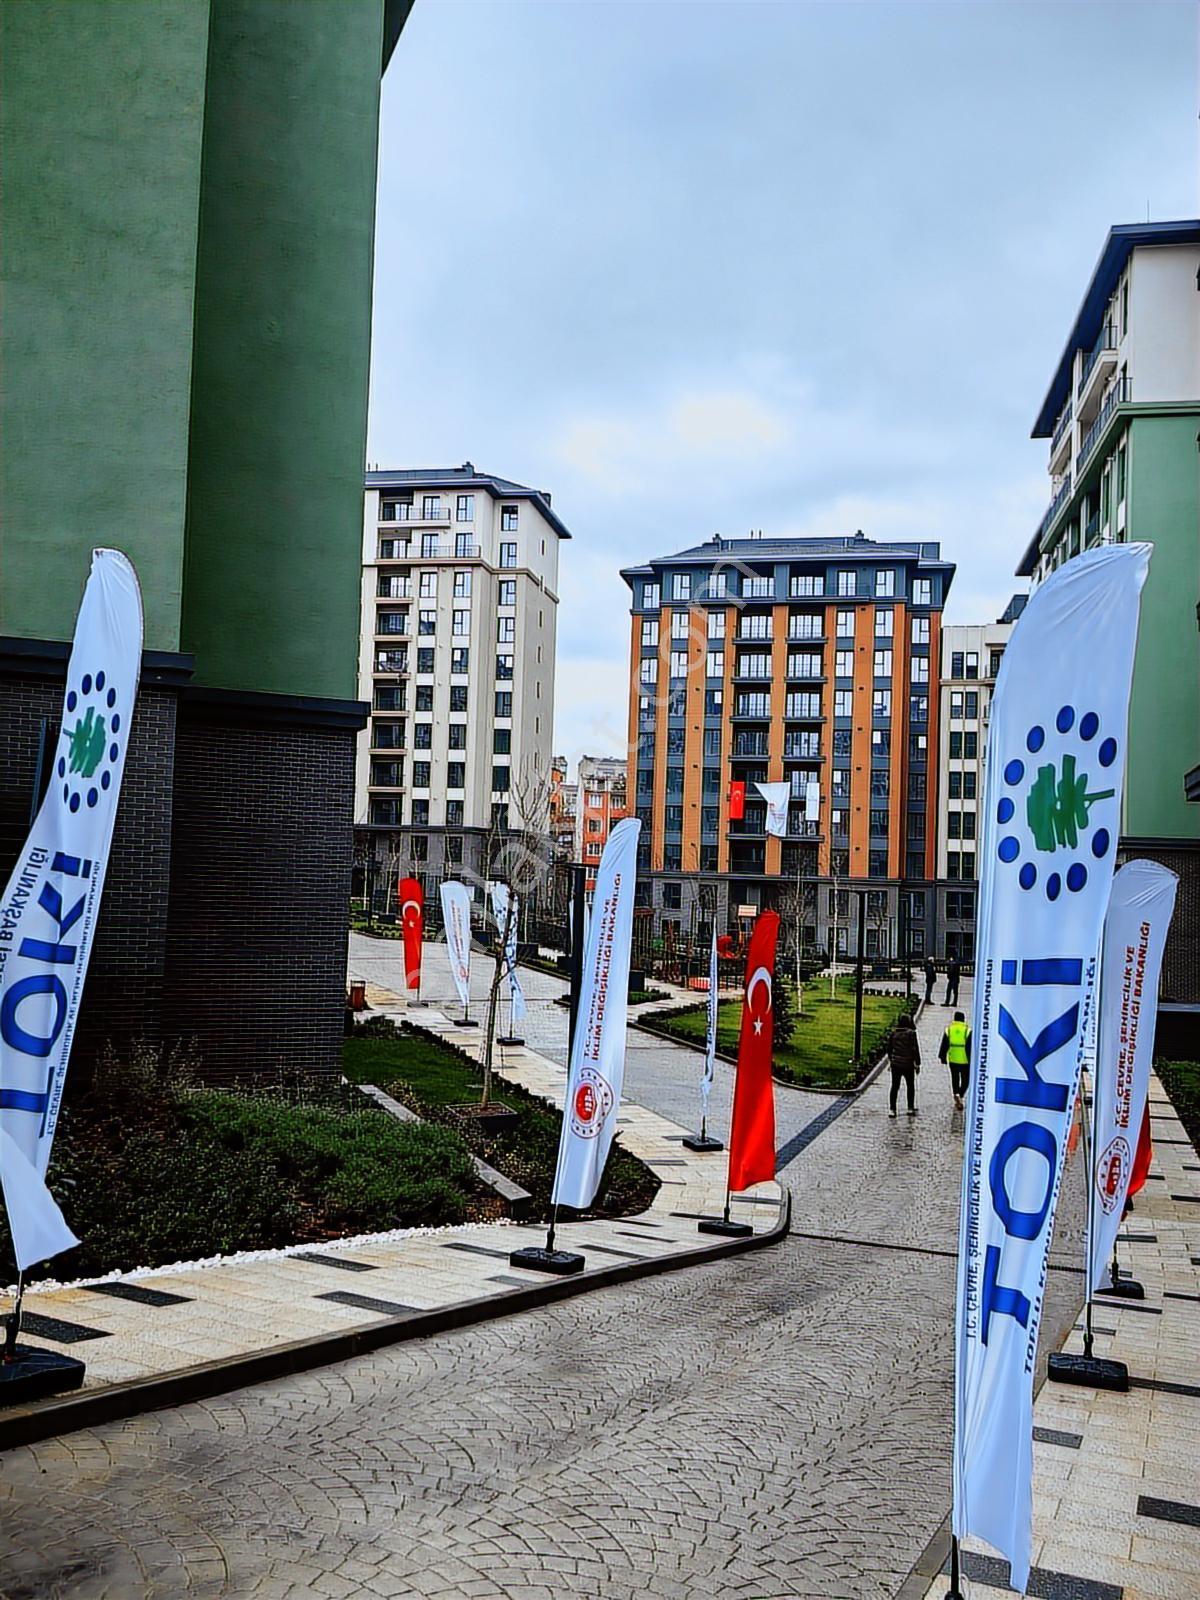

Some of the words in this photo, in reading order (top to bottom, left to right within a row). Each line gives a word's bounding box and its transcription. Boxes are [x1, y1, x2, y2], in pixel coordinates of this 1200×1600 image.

[1125, 946, 1135, 963] VE
[1119, 1088, 1132, 1130] İKLİM
[1132, 921, 1151, 998] BAKANLIĞI
[973, 1159, 981, 1178] VE
[980, 958, 1083, 1348] TOKİ
[1023, 1295, 1041, 1376] TOPLU
